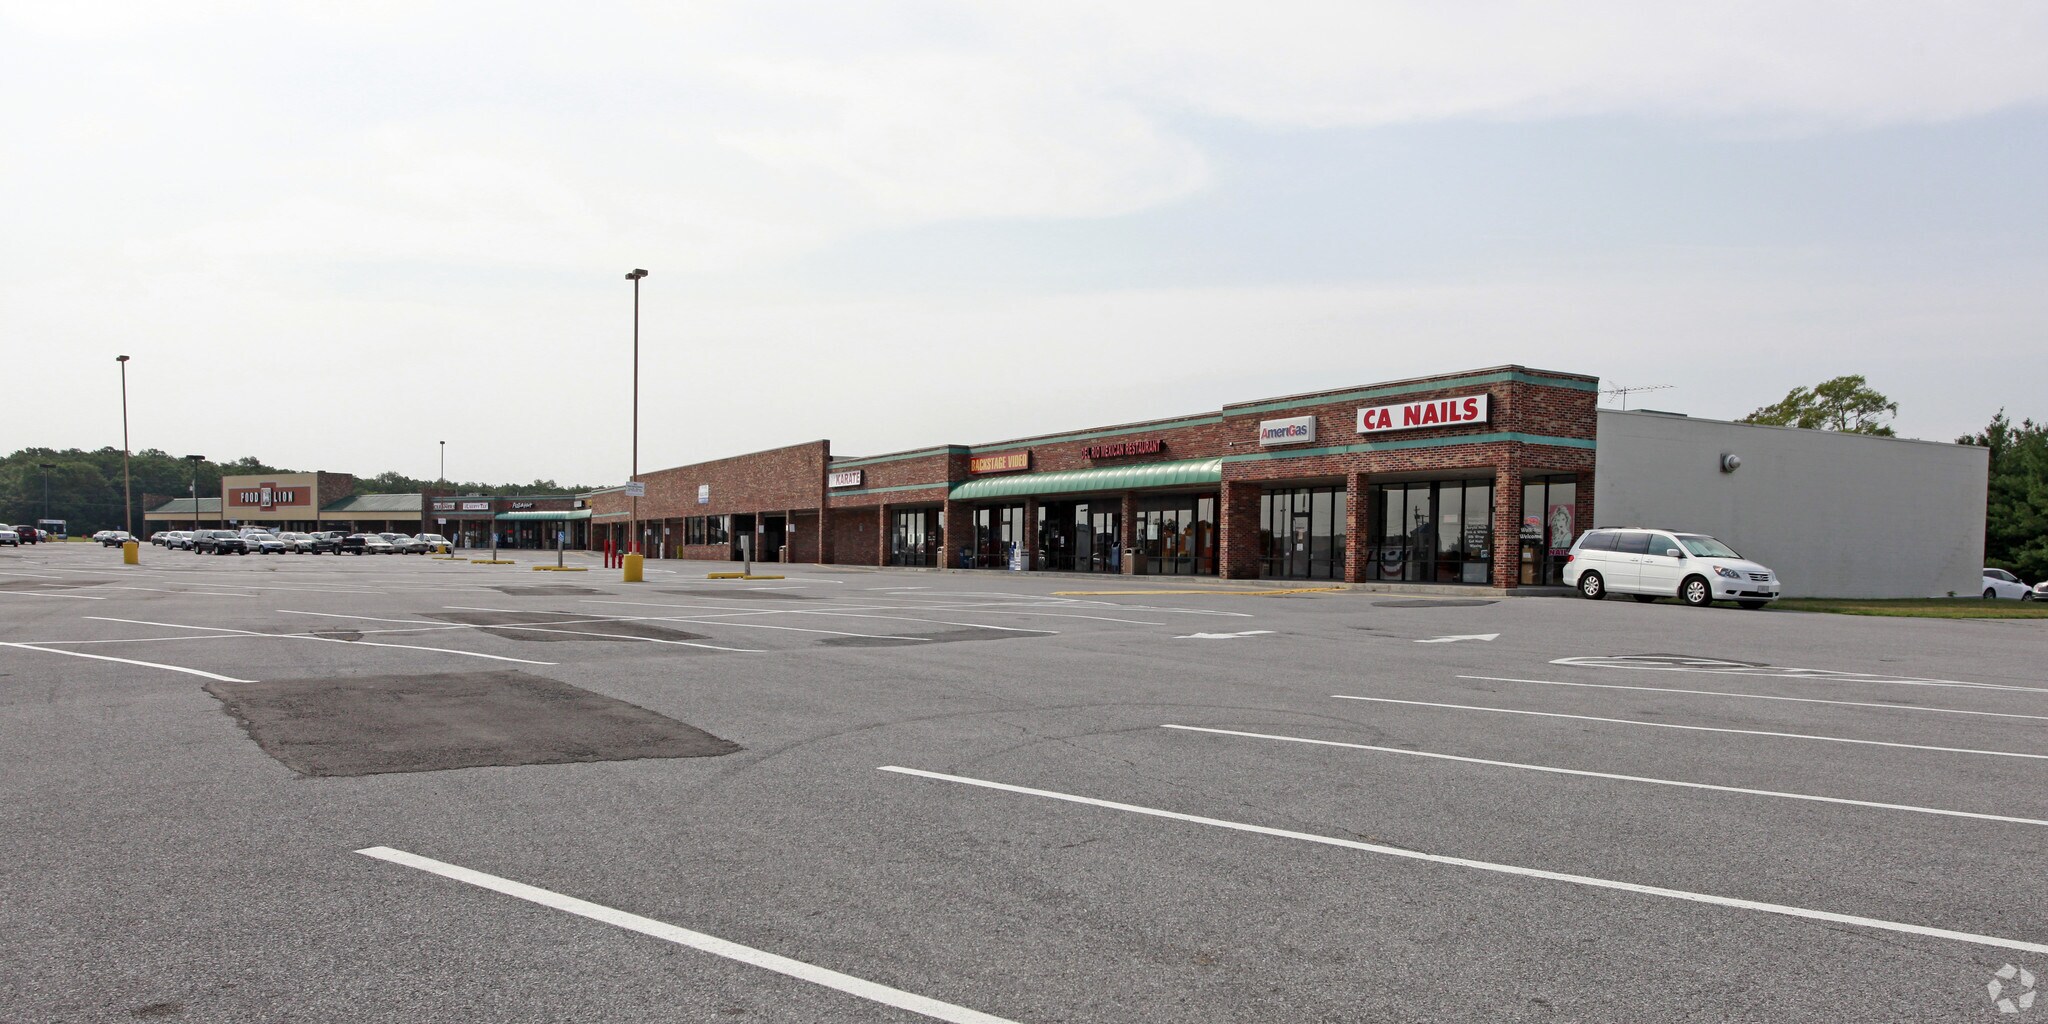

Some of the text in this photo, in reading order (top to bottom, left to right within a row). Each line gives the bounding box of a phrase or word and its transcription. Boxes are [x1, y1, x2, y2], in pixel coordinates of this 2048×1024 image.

[1364, 398, 1478, 430] CA NAILS
[1261, 424, 1307, 439] AmeriGas
[1102, 443, 1124, 457] MEXICAN
[1125, 439, 1160, 455] RESTAURANT
[971, 454, 1027, 471] BACKSTAGE VIDEO
[836, 472, 860, 485] KARATE
[240, 491, 293, 503] FOOD LION
